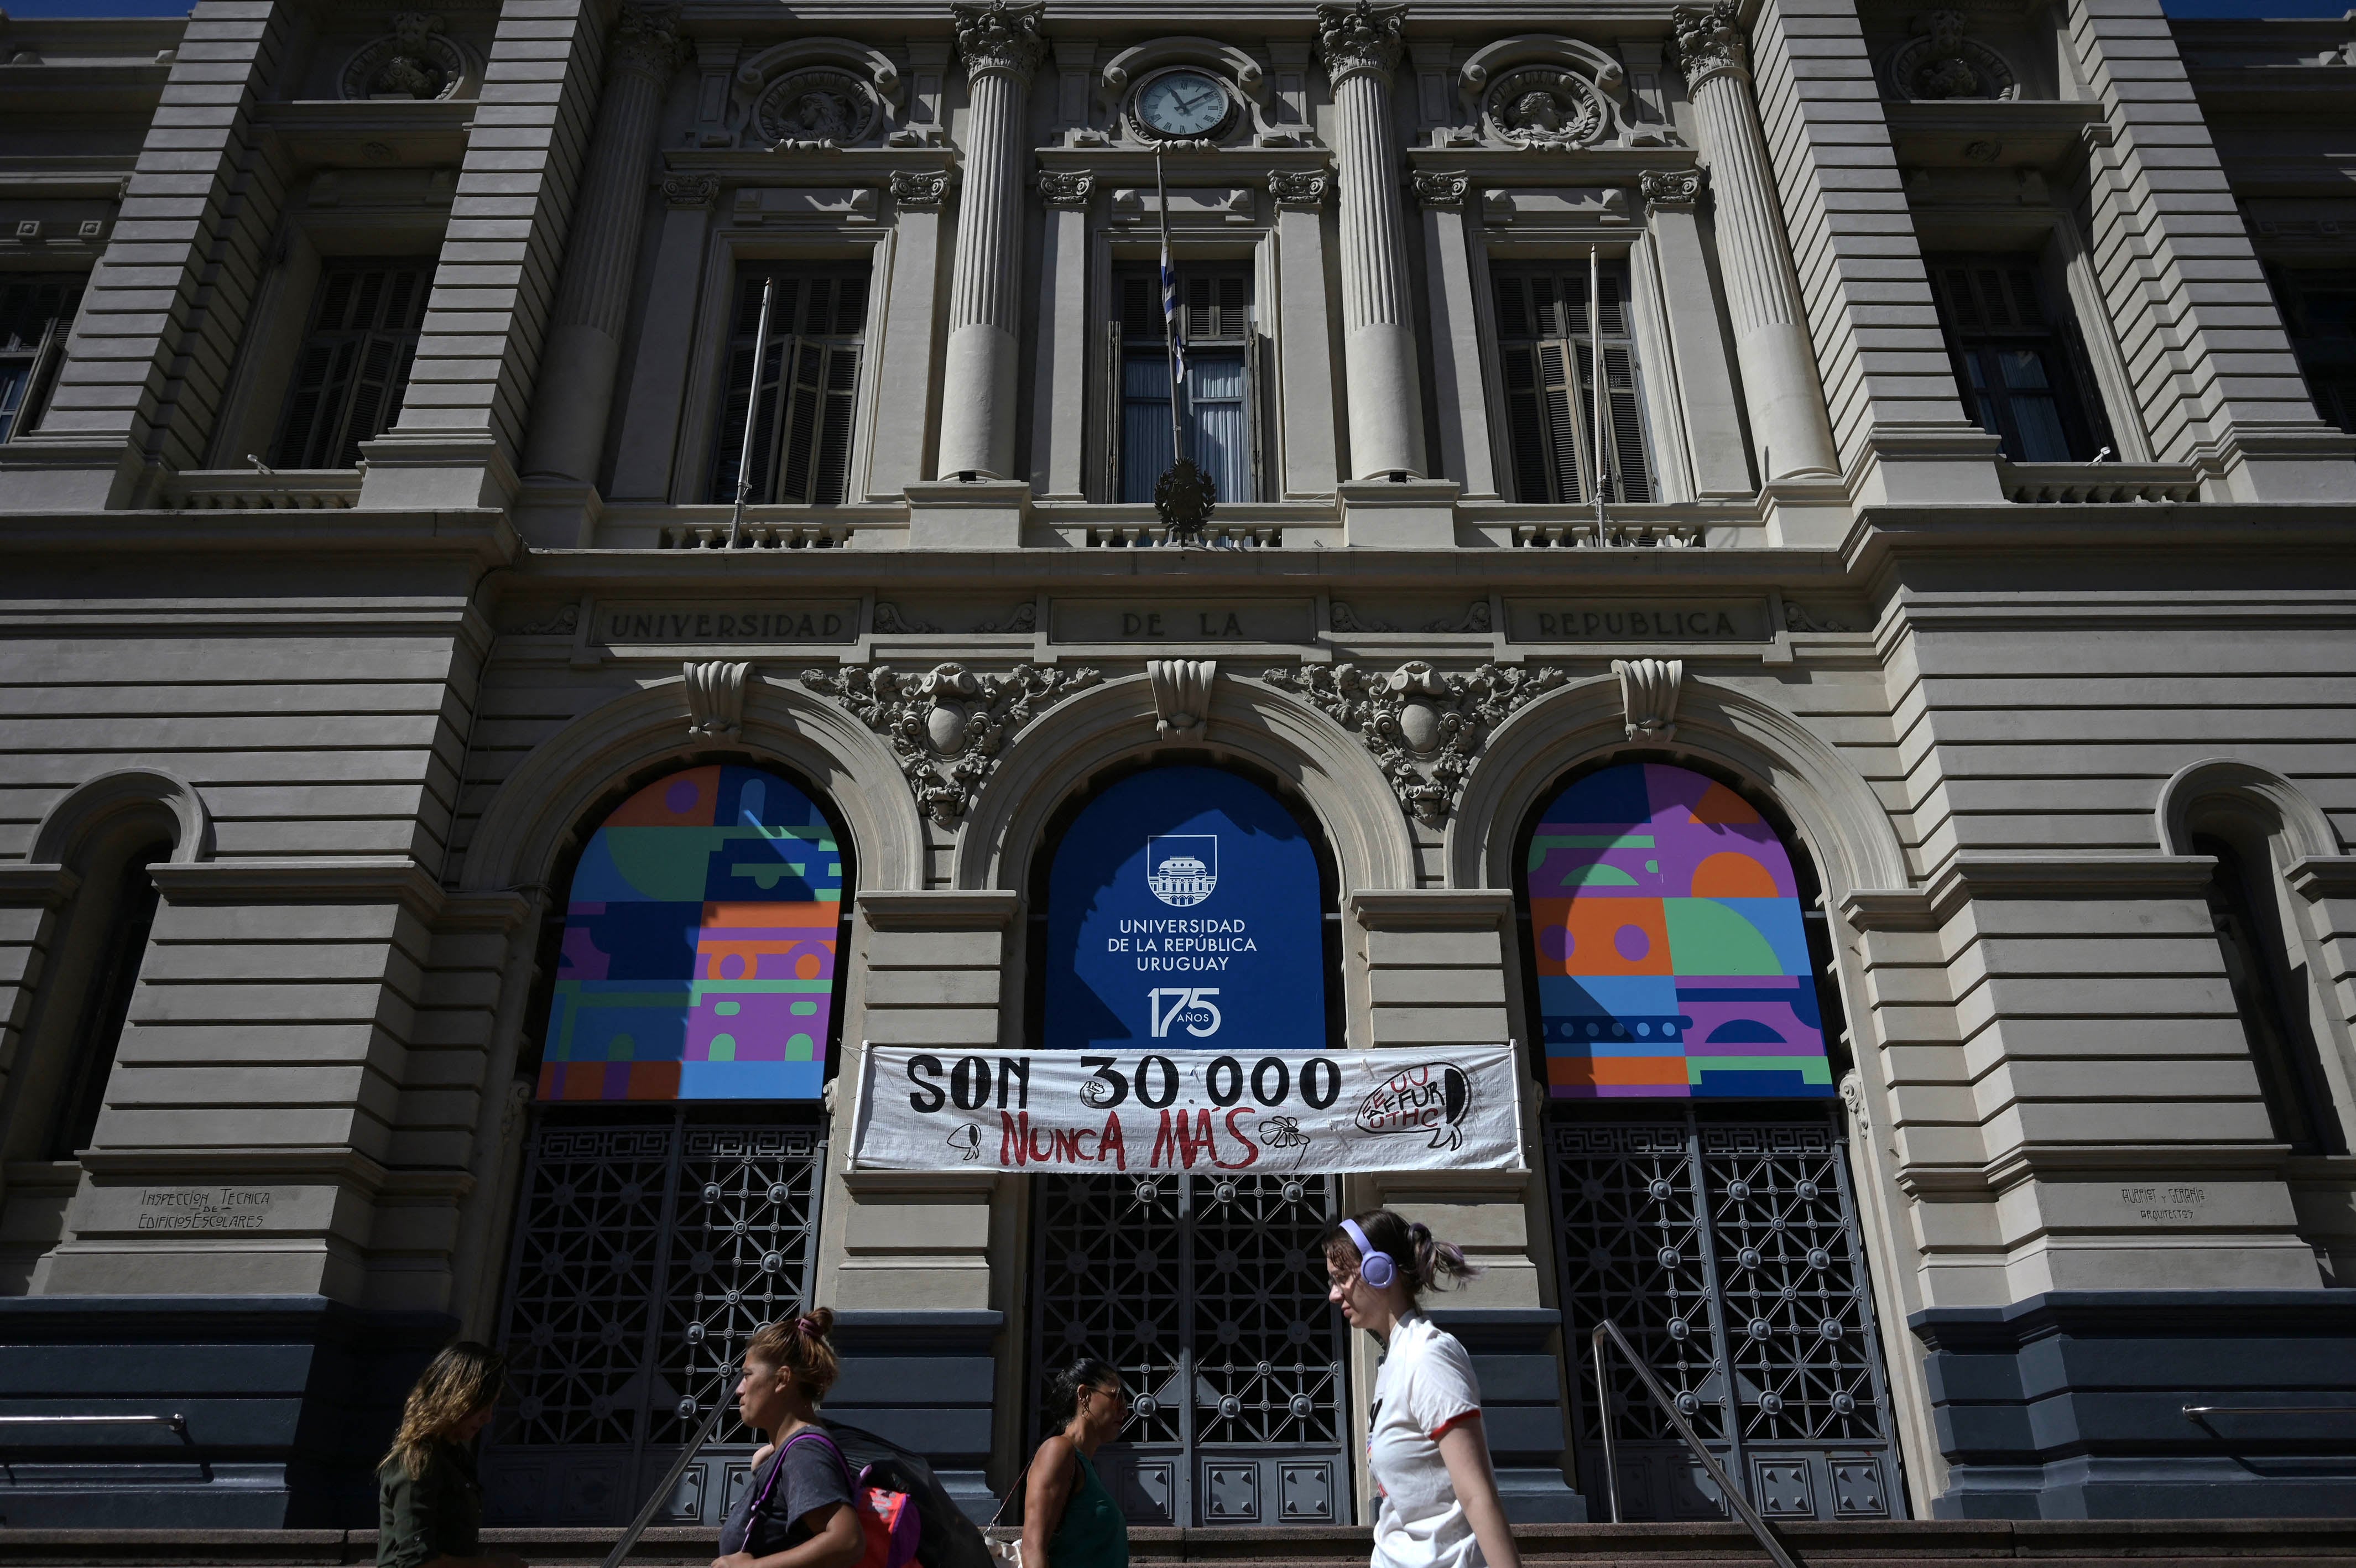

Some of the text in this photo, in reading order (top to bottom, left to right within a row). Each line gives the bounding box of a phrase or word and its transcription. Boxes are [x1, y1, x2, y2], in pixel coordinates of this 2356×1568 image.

[611, 612, 1736, 638] UNIVERSIDAD DE LA REPUBLICA
[1120, 919, 1245, 934] UNIVERSIDAD
[1108, 934, 1257, 952] DE LA REPÚBLICA
[1137, 957, 1229, 972] URUGUAY
[1147, 988, 1221, 1038] 175
[1177, 1012, 1209, 1023] AÑOS
[907, 1054, 1030, 1113] SON
[1370, 1108, 1438, 1128] UTHC
[1000, 1110, 1126, 1171] NUNCA
[220, 1188, 270, 1205] TECNICA
[192, 1213, 263, 1228] ESCOLARES
